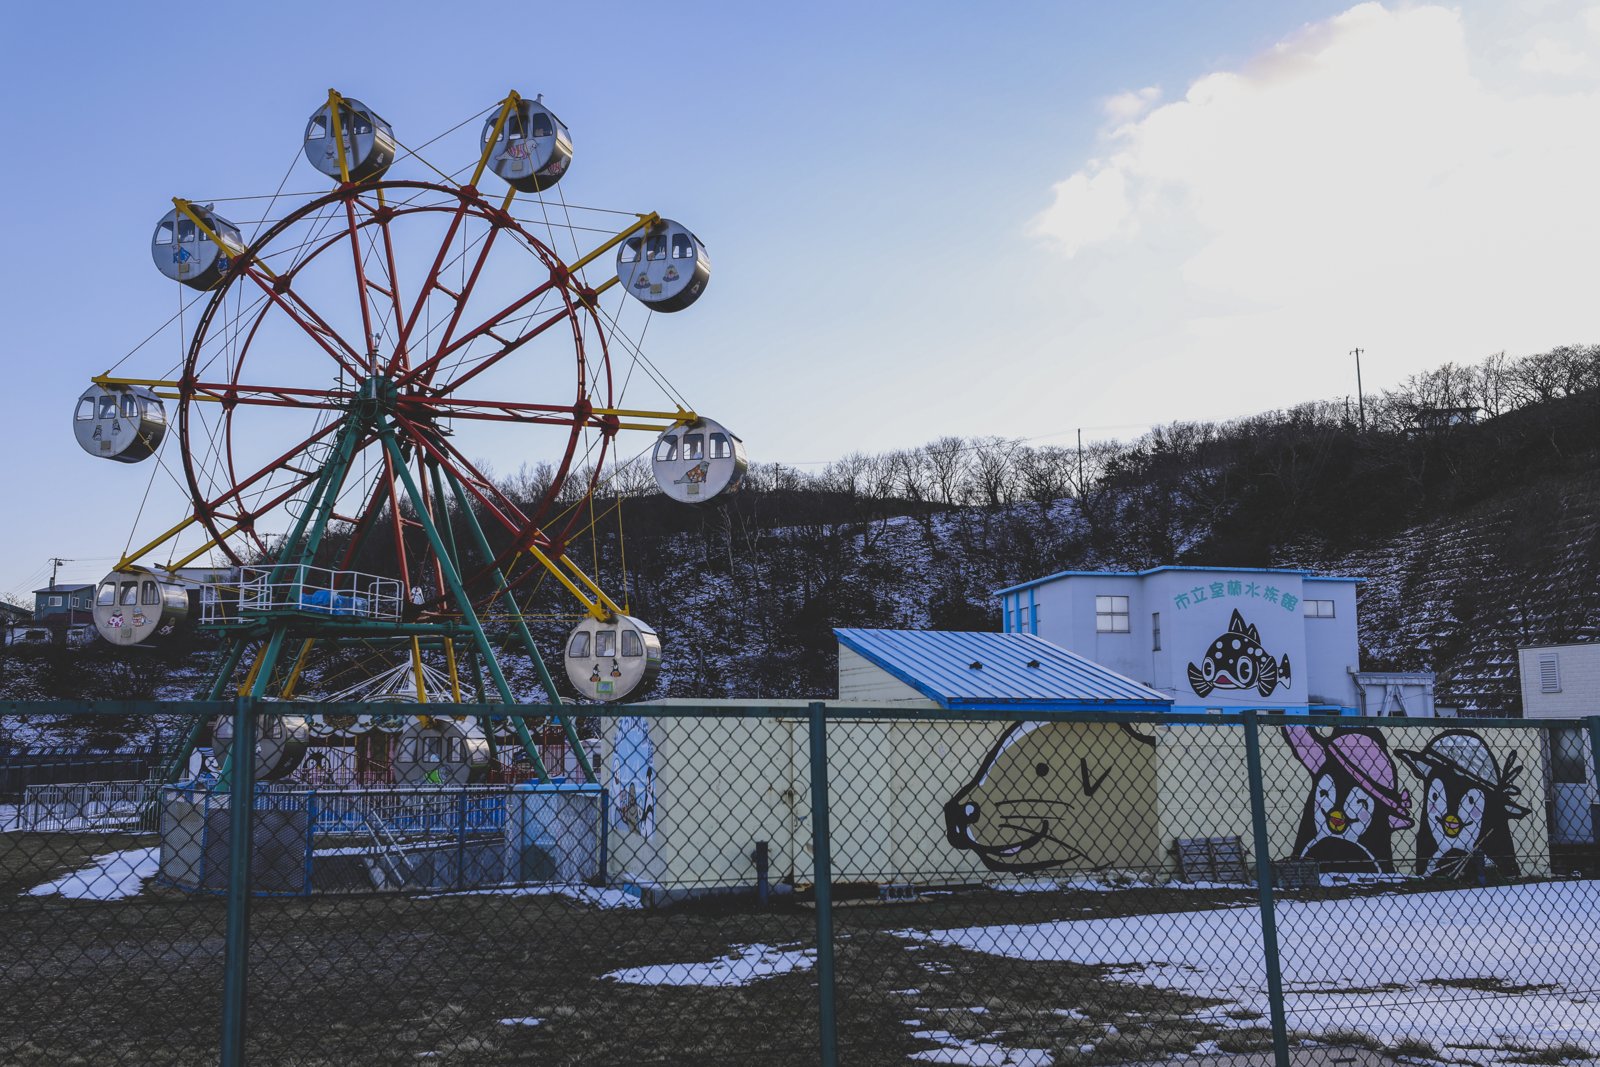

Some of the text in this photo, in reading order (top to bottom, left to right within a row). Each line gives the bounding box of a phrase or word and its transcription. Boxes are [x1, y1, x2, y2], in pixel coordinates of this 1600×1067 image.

[1174, 579, 1298, 612] 市立室蘭水族館
